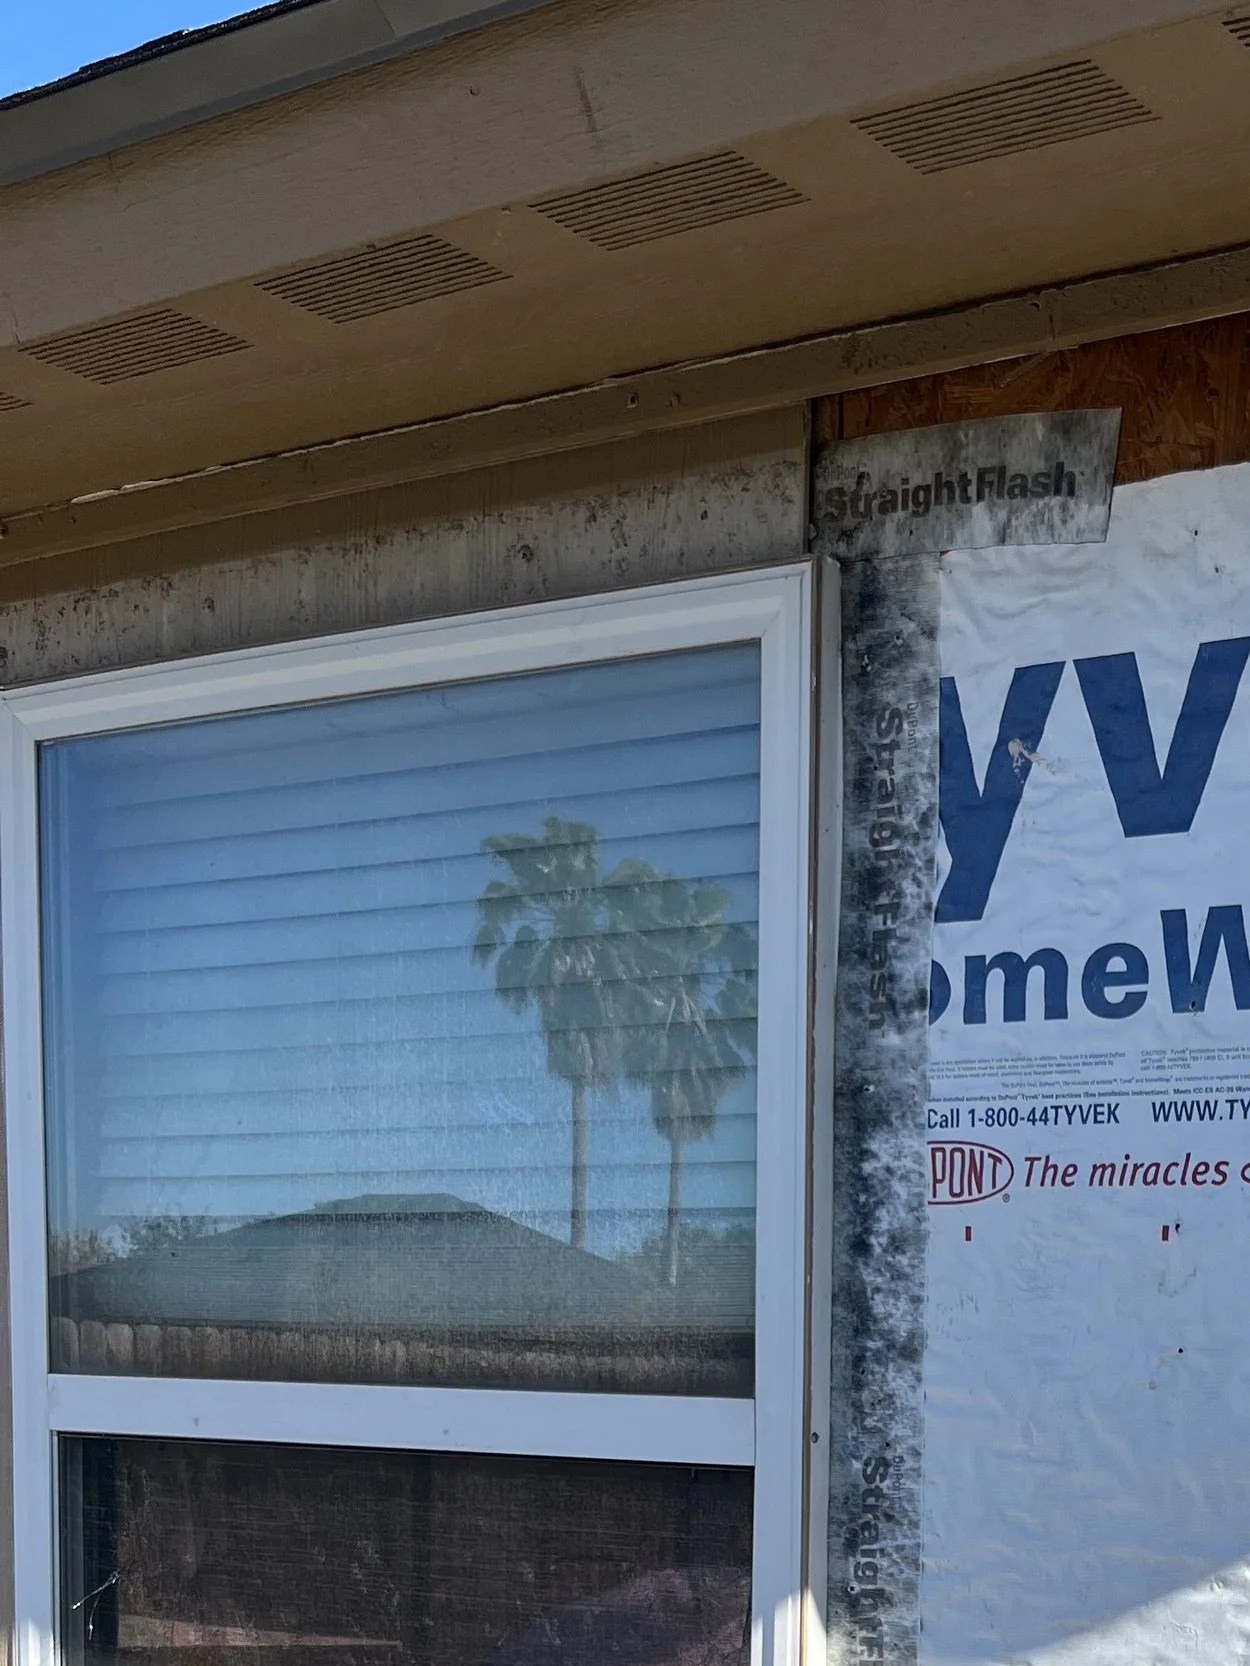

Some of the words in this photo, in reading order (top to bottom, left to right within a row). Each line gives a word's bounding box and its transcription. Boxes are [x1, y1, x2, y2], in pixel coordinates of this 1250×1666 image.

[927, 1107, 960, 1129] Call
[967, 1102, 1120, 1128] 1-800-44TYVEK
[1024, 1154, 1078, 1187] The
[1088, 1152, 1229, 1187] miracles
